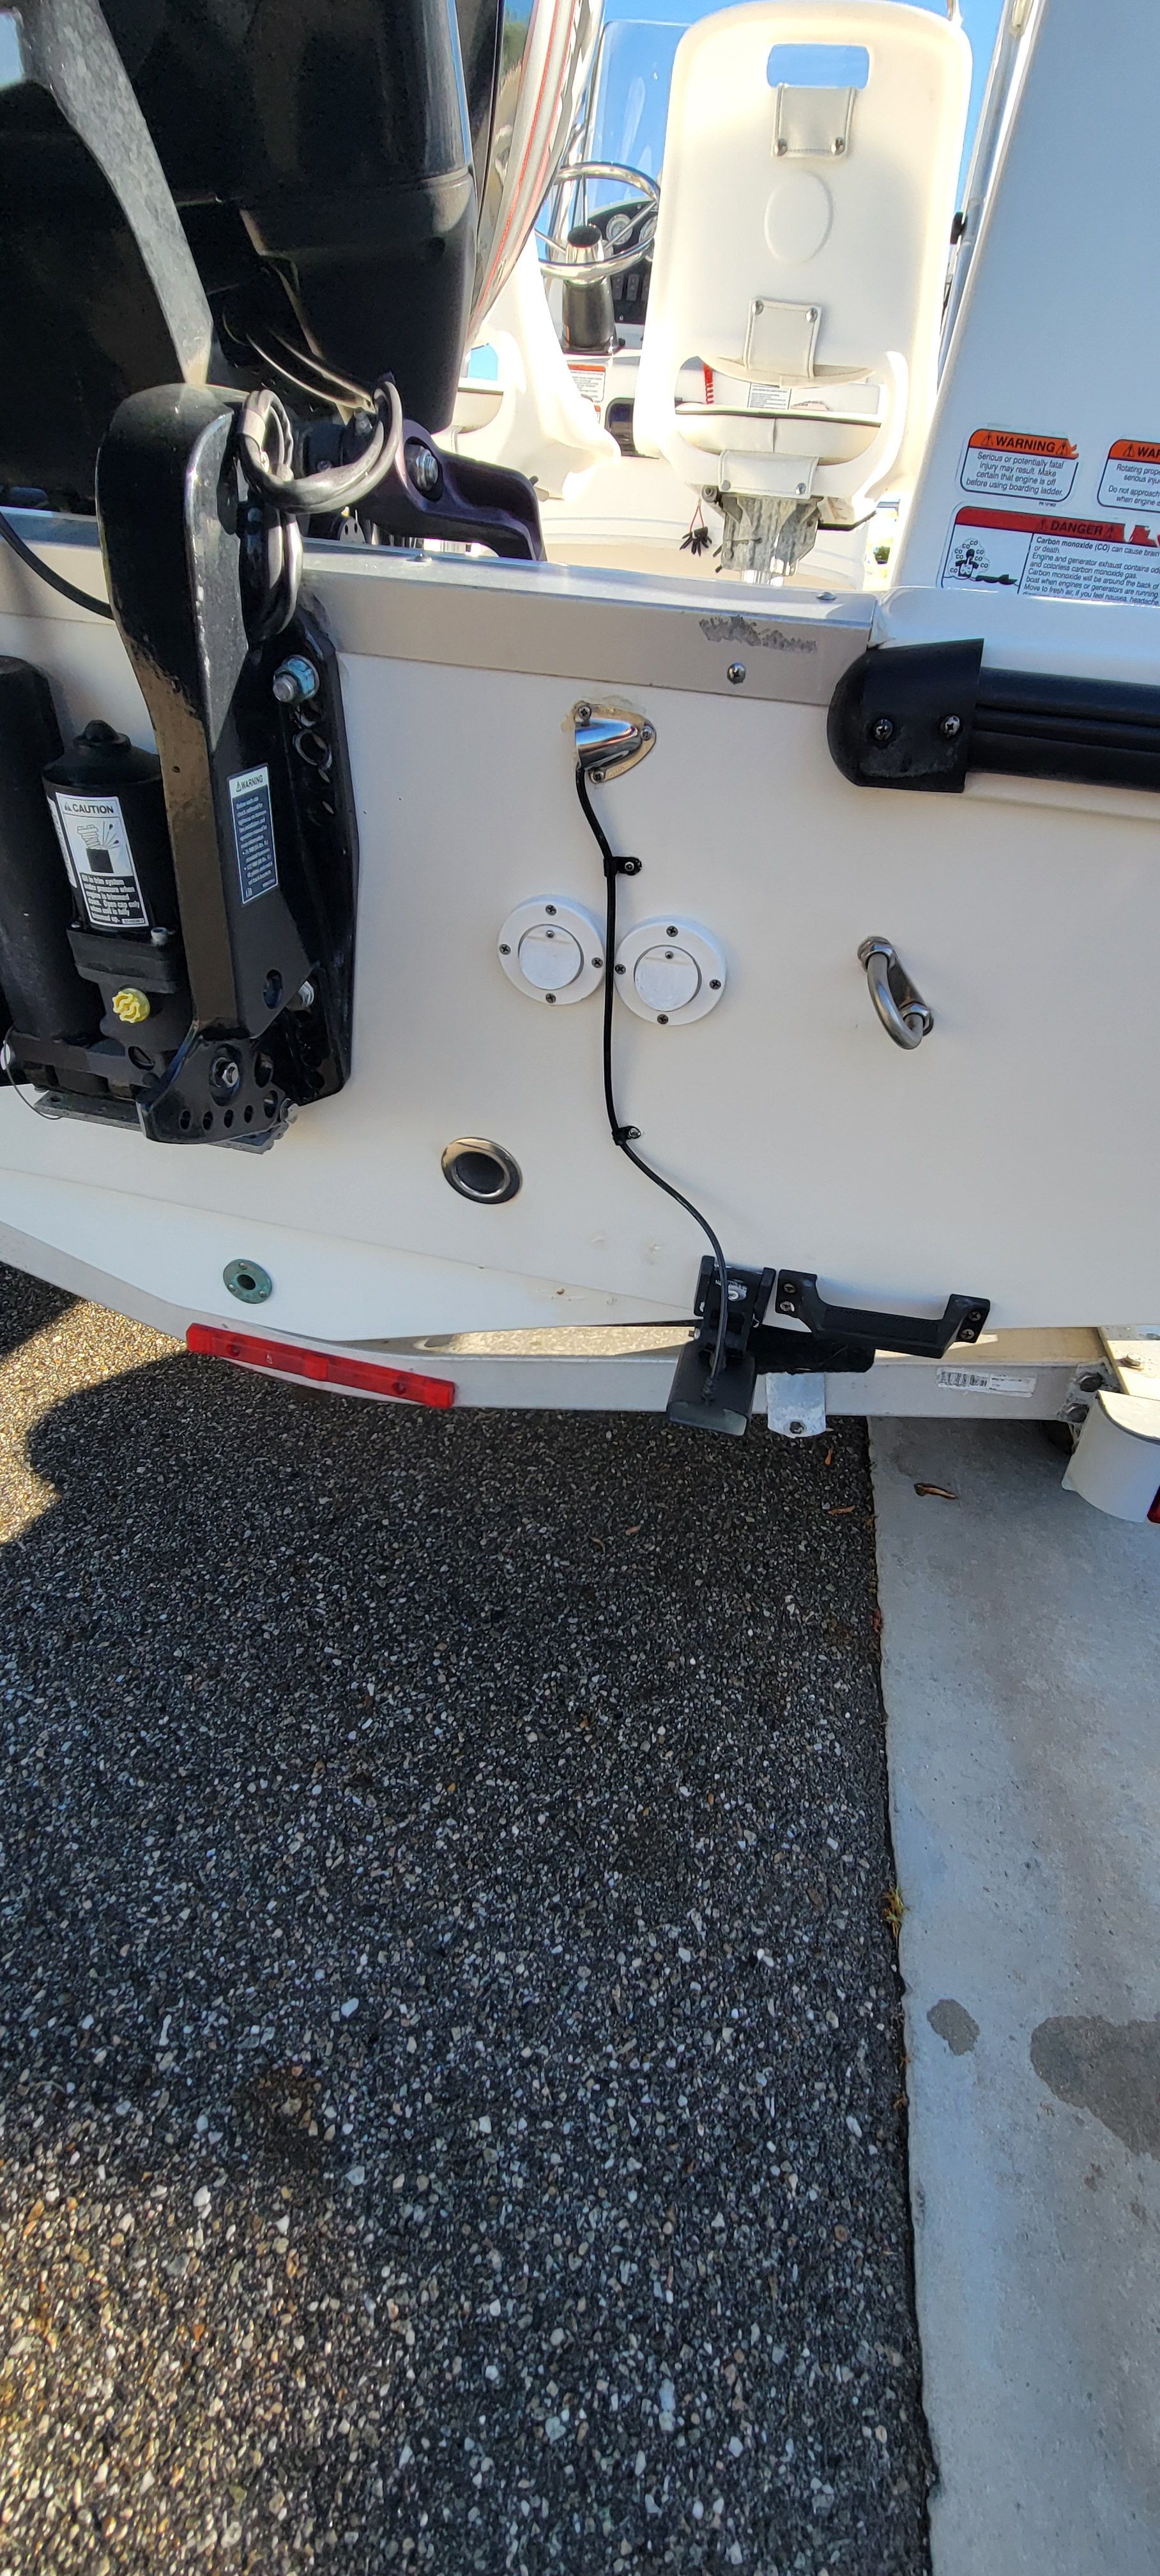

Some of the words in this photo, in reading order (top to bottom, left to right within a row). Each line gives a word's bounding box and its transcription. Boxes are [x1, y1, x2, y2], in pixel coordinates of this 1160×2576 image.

[996, 435, 1055, 452] WARNING
[977, 452, 1003, 462] Serious
[1013, 457, 1048, 470] potentially
[1049, 461, 1064, 470] fatal
[979, 461, 998, 474] injury
[1038, 469, 1057, 477] Make
[976, 470, 999, 479] certain
[1015, 476, 1038, 484] engine
[1117, 464, 1143, 475] Rotating
[966, 479, 988, 487] before
[989, 482, 1008, 491] using
[1009, 484, 1039, 495] boarding
[1041, 488, 1063, 496] ladder.
[1134, 498, 1156, 506] engine
[1050, 520, 1103, 536] DANGER
[1036, 537, 1060, 545] Carbon
[1061, 540, 1093, 549] monoxide
[1094, 544, 1110, 553] (CO)
[1032, 553, 1054, 562] Engine
[1098, 561, 1122, 569] exhaust
[1124, 564, 1150, 572] contains
[1028, 568, 1051, 576] Carbon
[1094, 569, 1124, 577] monoxide
[1058, 581, 1083, 589] engines
[1090, 584, 1124, 594] generators
[241, 774, 263, 790] WARNING
[72, 803, 114, 814] CAUTION
